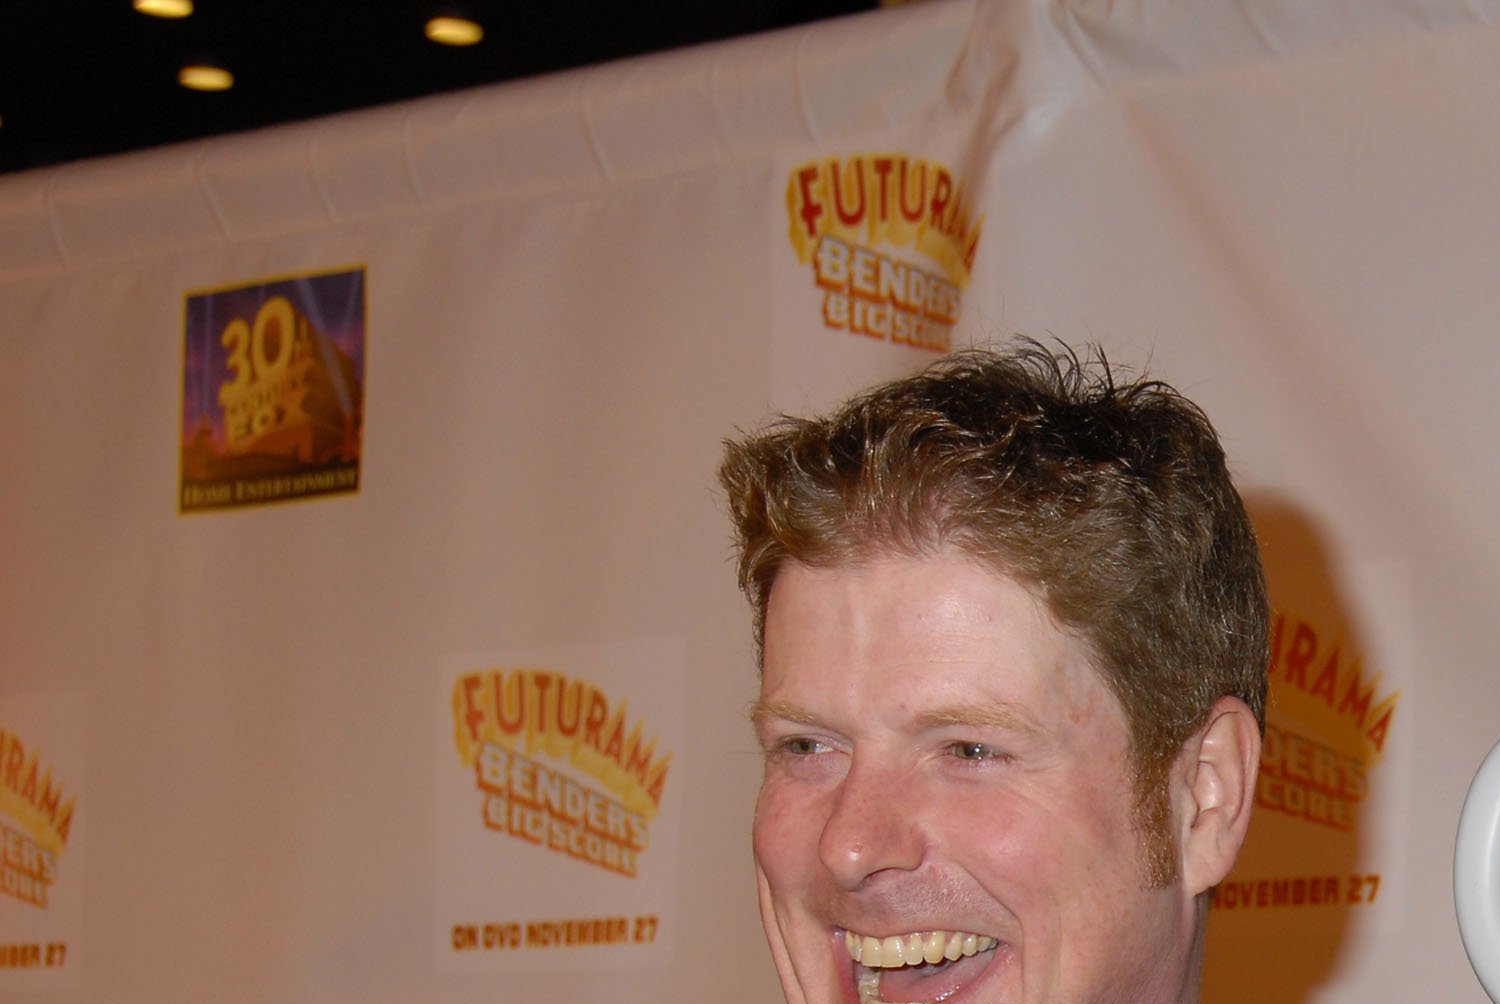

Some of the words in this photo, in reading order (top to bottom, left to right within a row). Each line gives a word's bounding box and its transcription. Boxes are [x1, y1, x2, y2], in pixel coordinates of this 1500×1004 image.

[460, 670, 671, 808] FUTURAMA
[1347, 873, 1381, 905] 27
[526, 916, 629, 948] NOVEMBER
